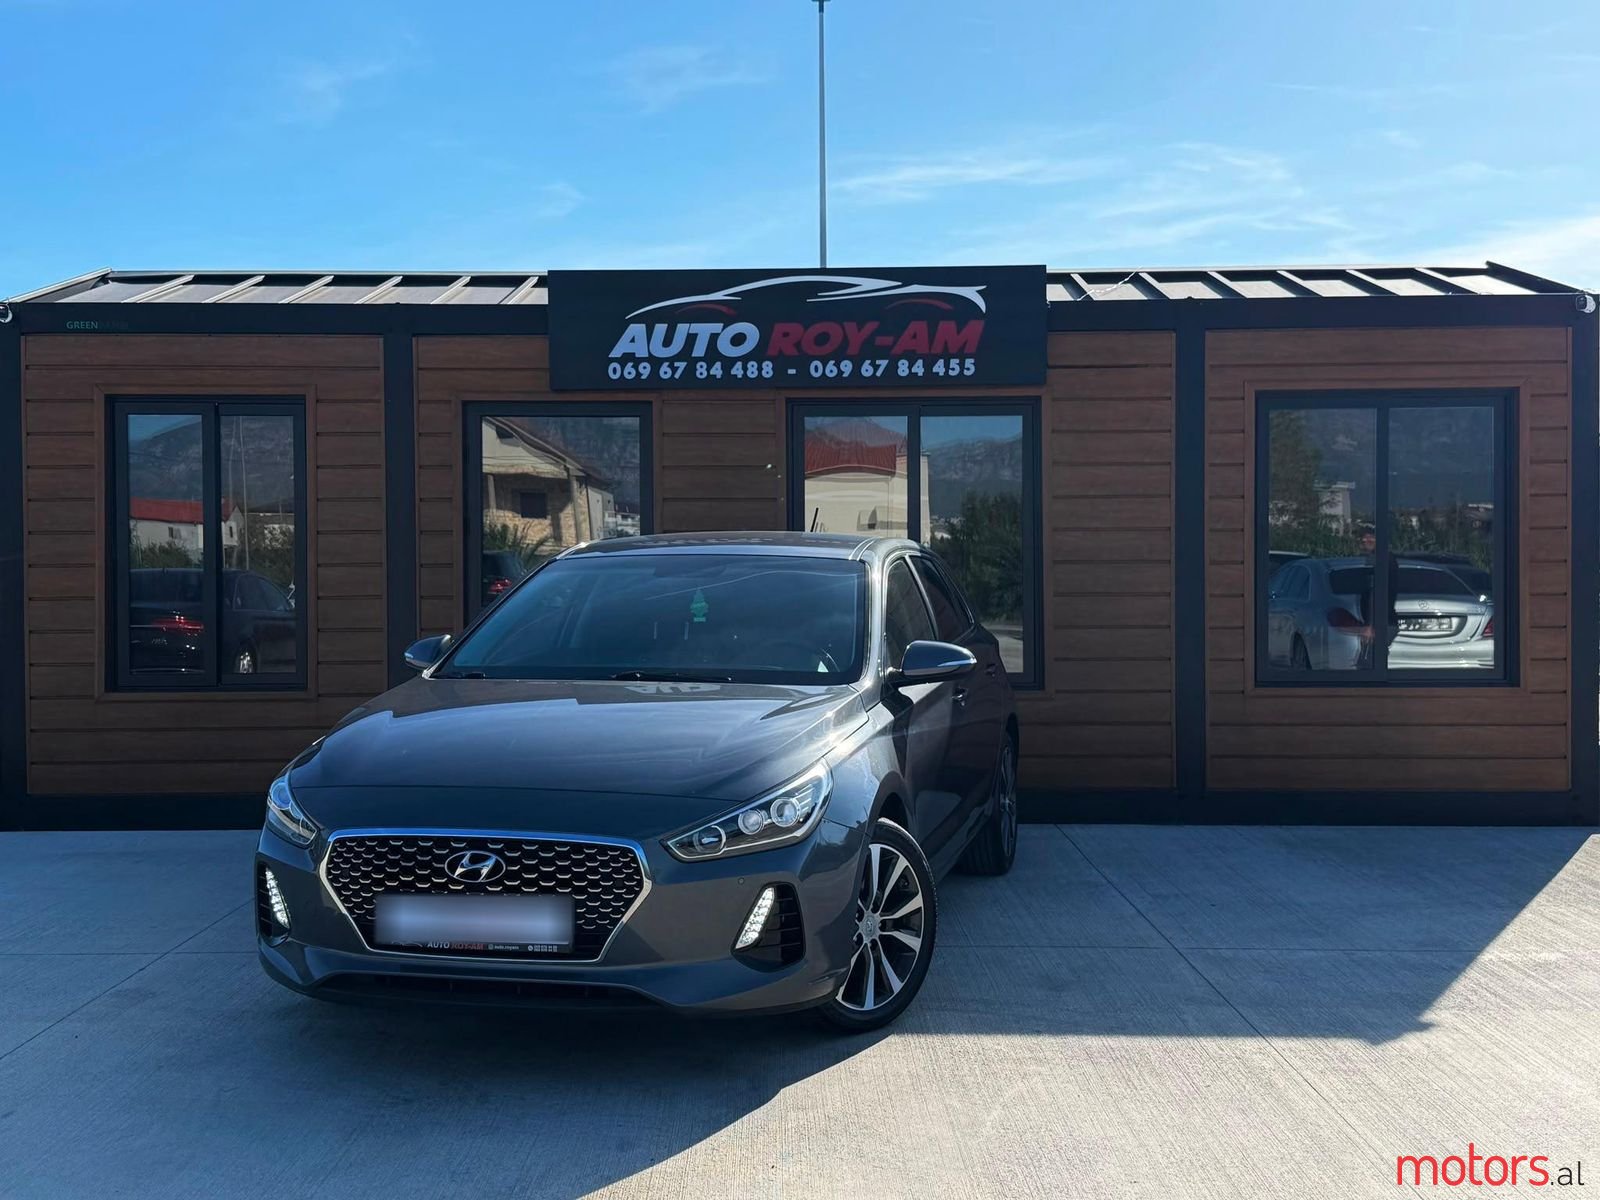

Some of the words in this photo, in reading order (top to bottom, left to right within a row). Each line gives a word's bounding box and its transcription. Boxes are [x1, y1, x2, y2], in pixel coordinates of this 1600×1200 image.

[66, 320, 98, 329] GREEN
[608, 322, 760, 358] AUTO
[768, 321, 983, 356] ROY-AM
[607, 361, 651, 380] 069
[659, 361, 686, 379] 67
[696, 361, 723, 379] 84
[730, 361, 774, 379] 488
[809, 360, 853, 378] 069
[860, 359, 888, 378] 67
[897, 359, 925, 378] 84
[932, 358, 976, 377] 455
